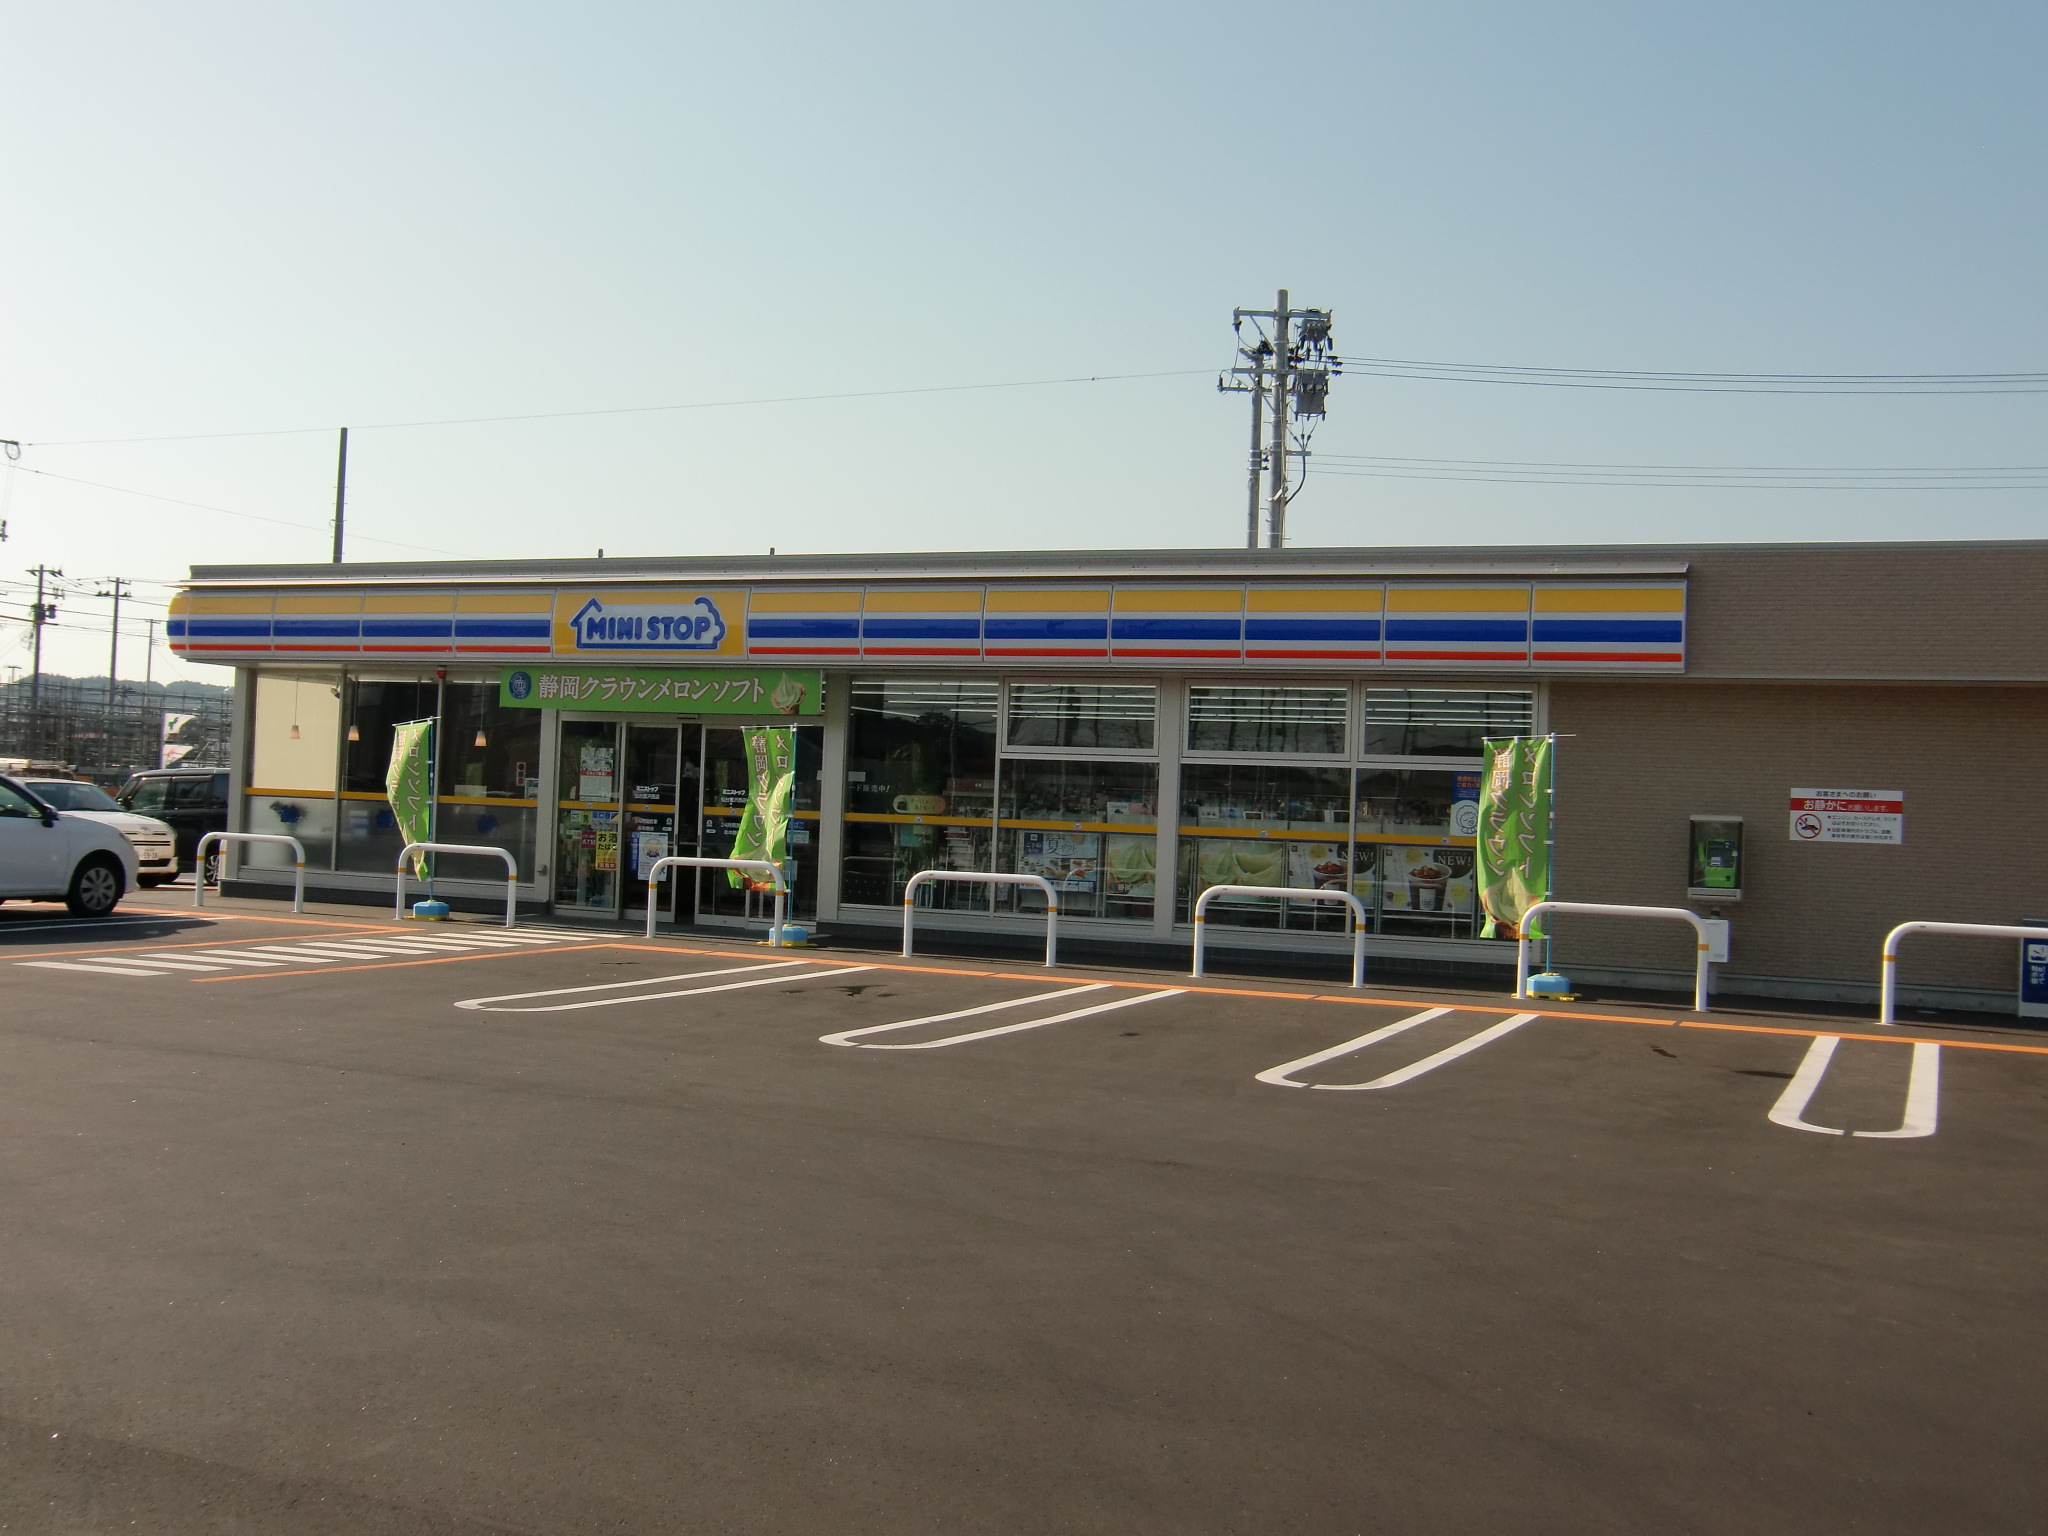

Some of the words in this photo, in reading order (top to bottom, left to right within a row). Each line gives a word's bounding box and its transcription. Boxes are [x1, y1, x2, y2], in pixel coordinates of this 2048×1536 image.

[586, 616, 642, 640] MINI
[646, 615, 711, 641] STOP
[538, 673, 765, 703] 静岡クラウンメロンソフト
[722, 788, 746, 796] ミニストップ
[1437, 855, 1471, 866] NEW!
